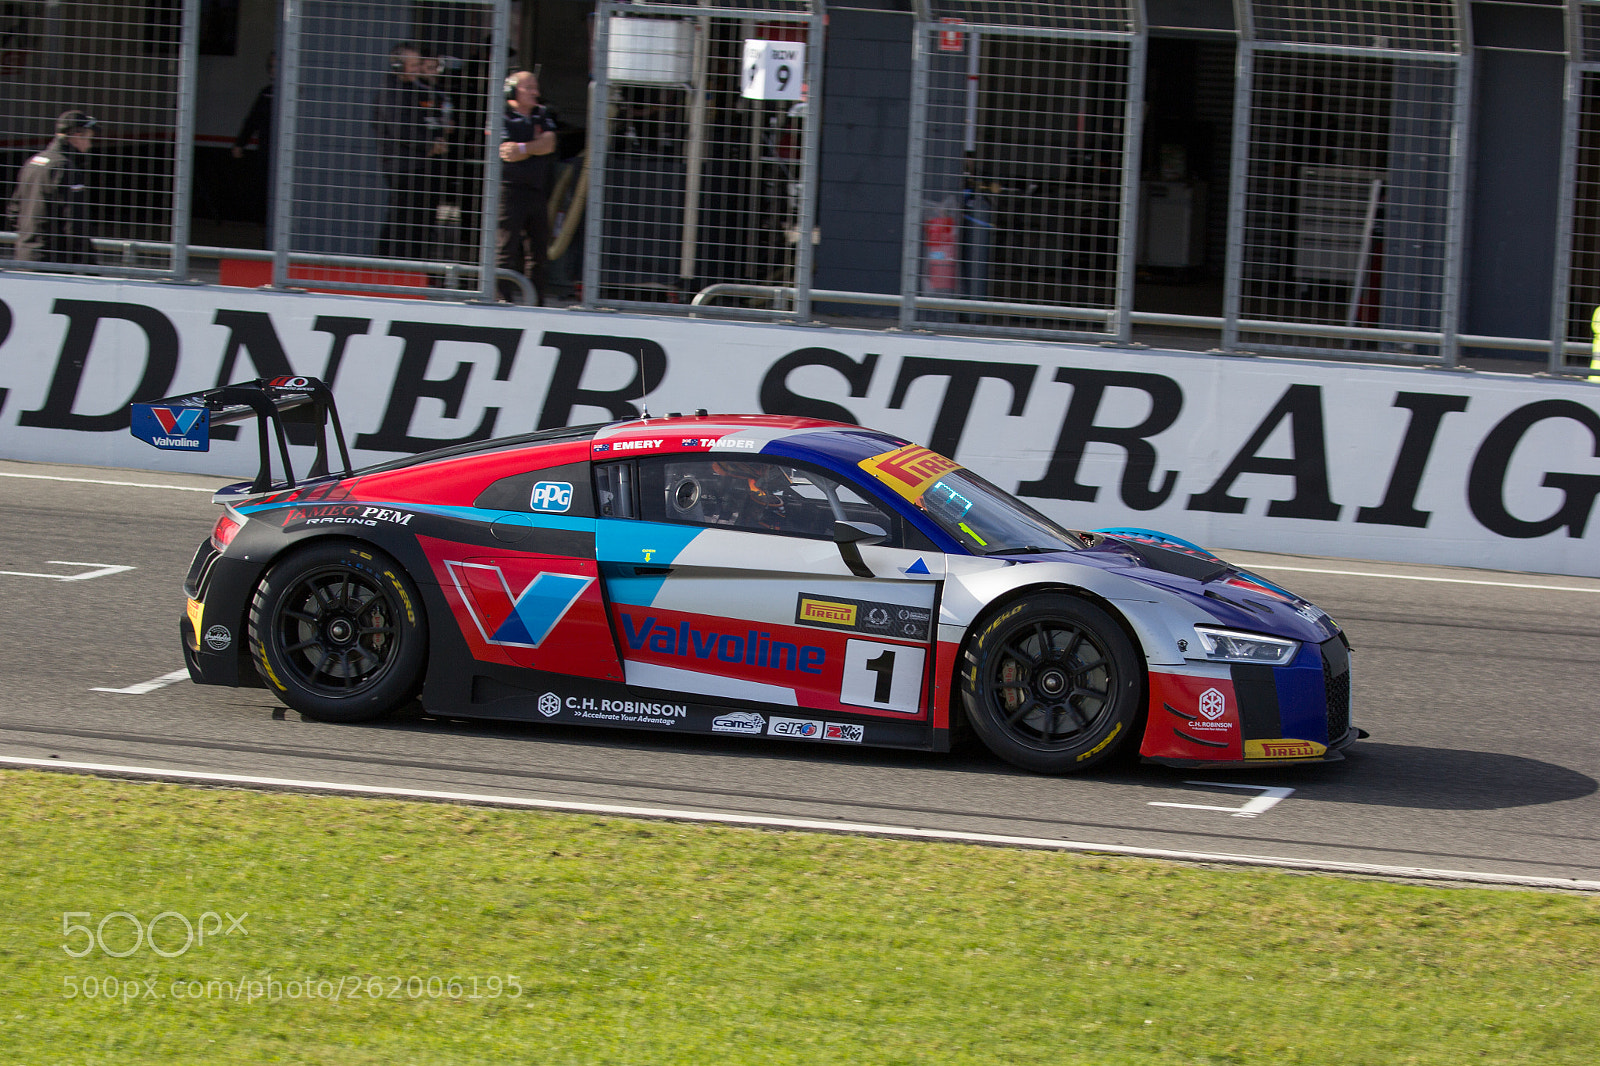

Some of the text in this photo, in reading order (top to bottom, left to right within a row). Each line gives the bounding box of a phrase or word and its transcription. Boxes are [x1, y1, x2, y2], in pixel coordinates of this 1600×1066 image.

[776, 65, 791, 91] 9
[0, 297, 668, 453] DNER
[152, 436, 200, 448] Valvoline
[612, 439, 664, 451] EMERY
[699, 438, 755, 449] TANDER
[875, 446, 962, 488] PIRE
[533, 484, 570, 509] PPG
[281, 505, 415, 527] JAMEC PEM
[305, 517, 378, 527] RACING
[805, 603, 852, 621] PIRELLI
[620, 612, 826, 675] Valvoline
[865, 649, 896, 704] 1
[565, 696, 687, 718] C.H. ROBINSON
[582, 711, 676, 726] Accelerate Your Advantage
[1202, 721, 1233, 729] ROBINSON
[774, 721, 802, 736] elf
[1261, 742, 1314, 757] PIRELLI
